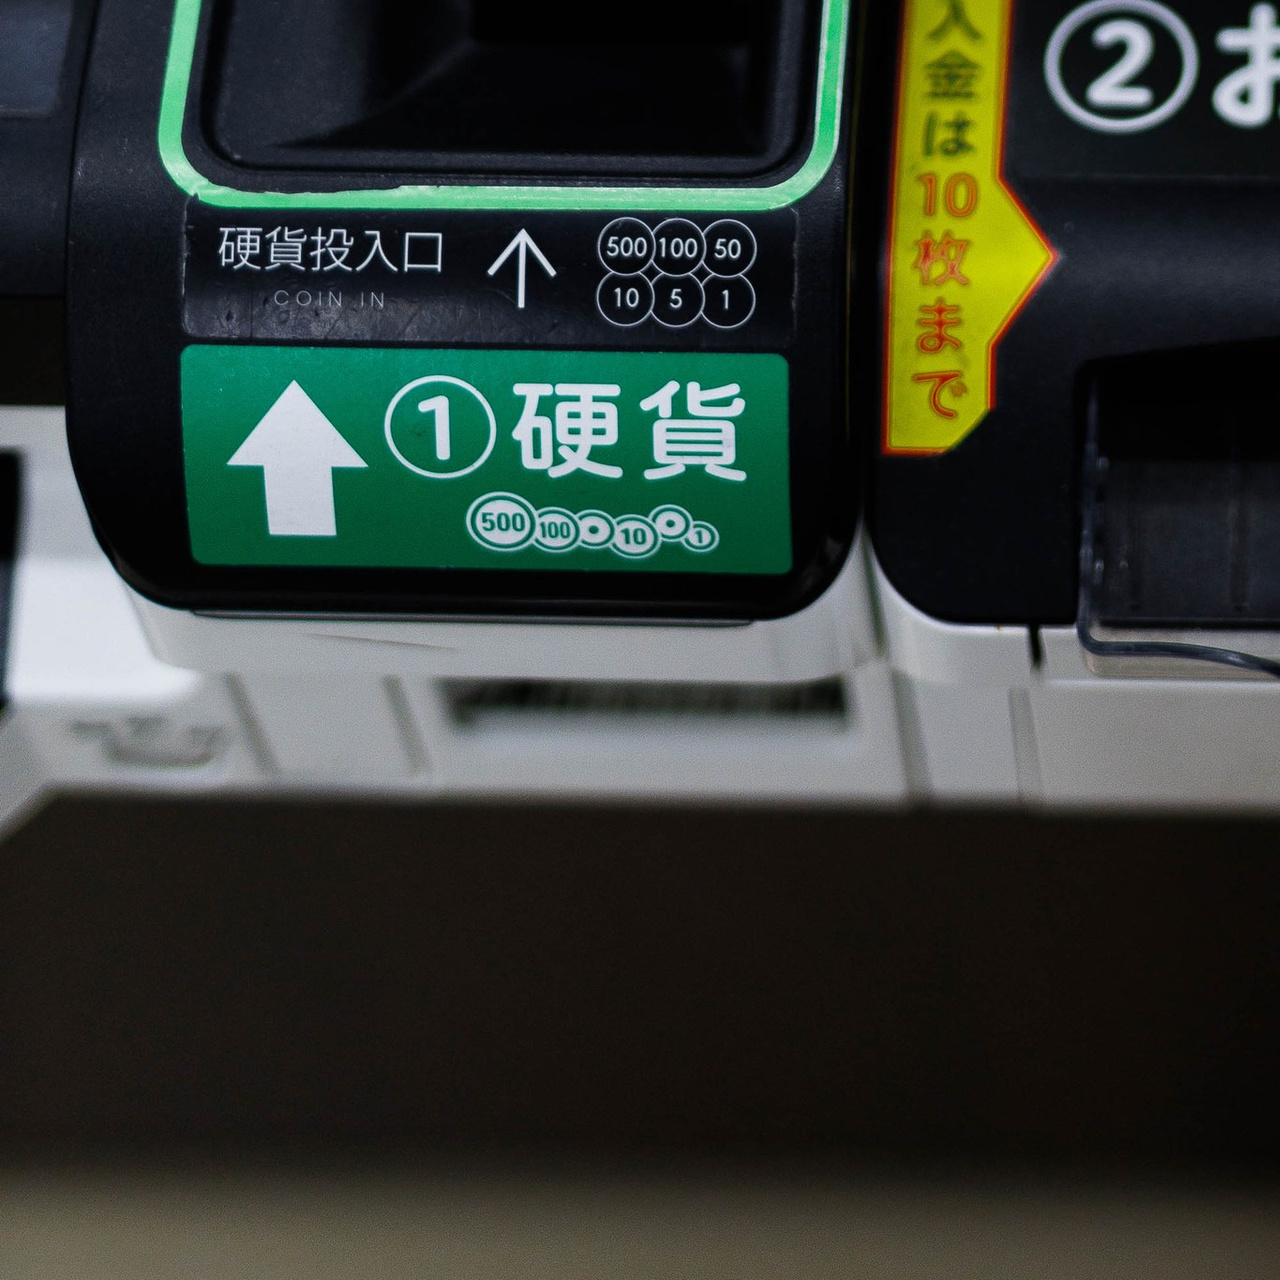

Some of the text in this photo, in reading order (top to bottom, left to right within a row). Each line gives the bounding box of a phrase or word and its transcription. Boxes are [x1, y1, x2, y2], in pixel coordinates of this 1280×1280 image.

[219, 226, 442, 273] 硬貨投入口
[607, 238, 741, 259] 500 100 50
[275, 289, 384, 308] COIN IN
[613, 288, 729, 308] 10 5 1
[481, 512, 526, 532] 500
[540, 521, 571, 540] 100
[620, 527, 647, 545] 10
